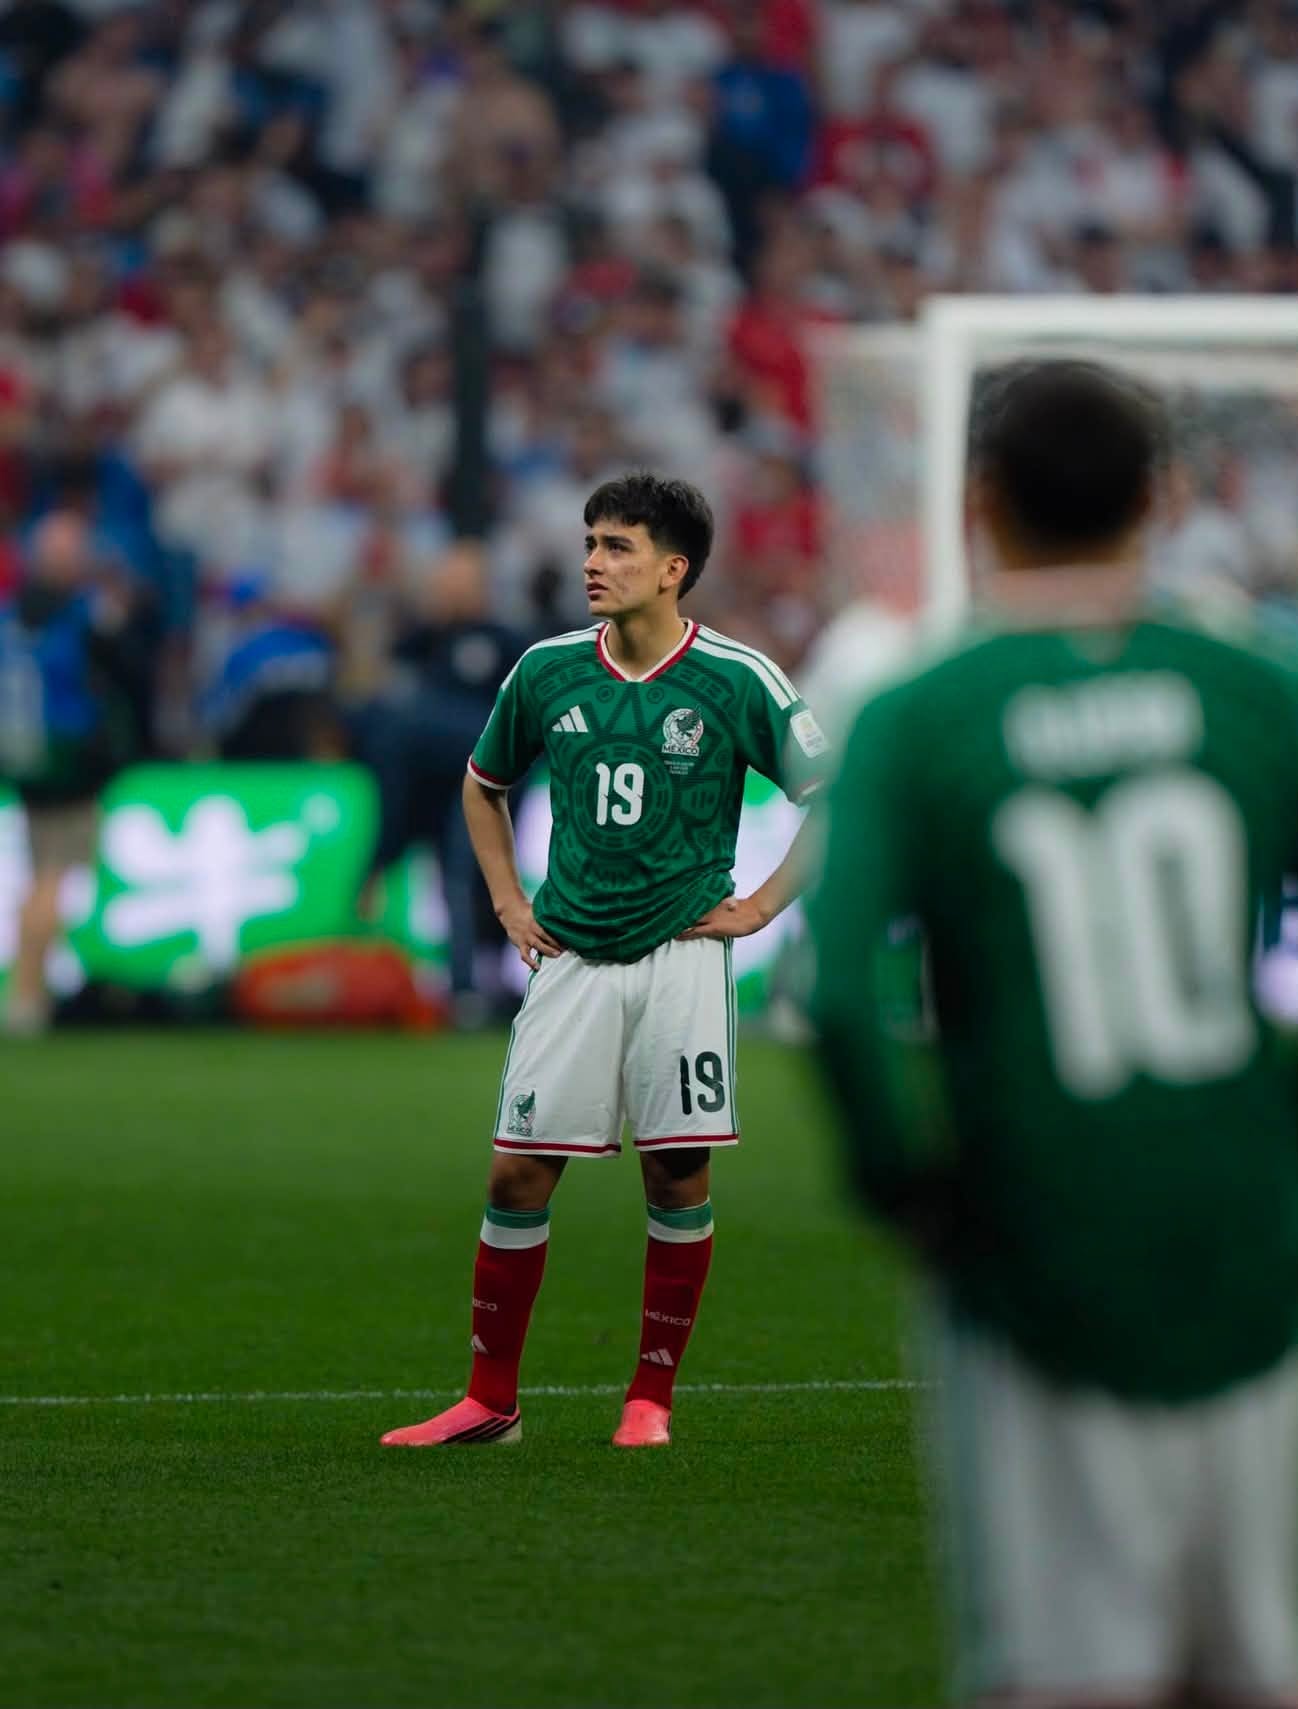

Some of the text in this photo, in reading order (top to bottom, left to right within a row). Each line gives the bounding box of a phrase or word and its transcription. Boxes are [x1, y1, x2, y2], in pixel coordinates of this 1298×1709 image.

[595, 762, 645, 826] 19
[992, 768, 1256, 1099] 10
[680, 1051, 725, 1115] 19
